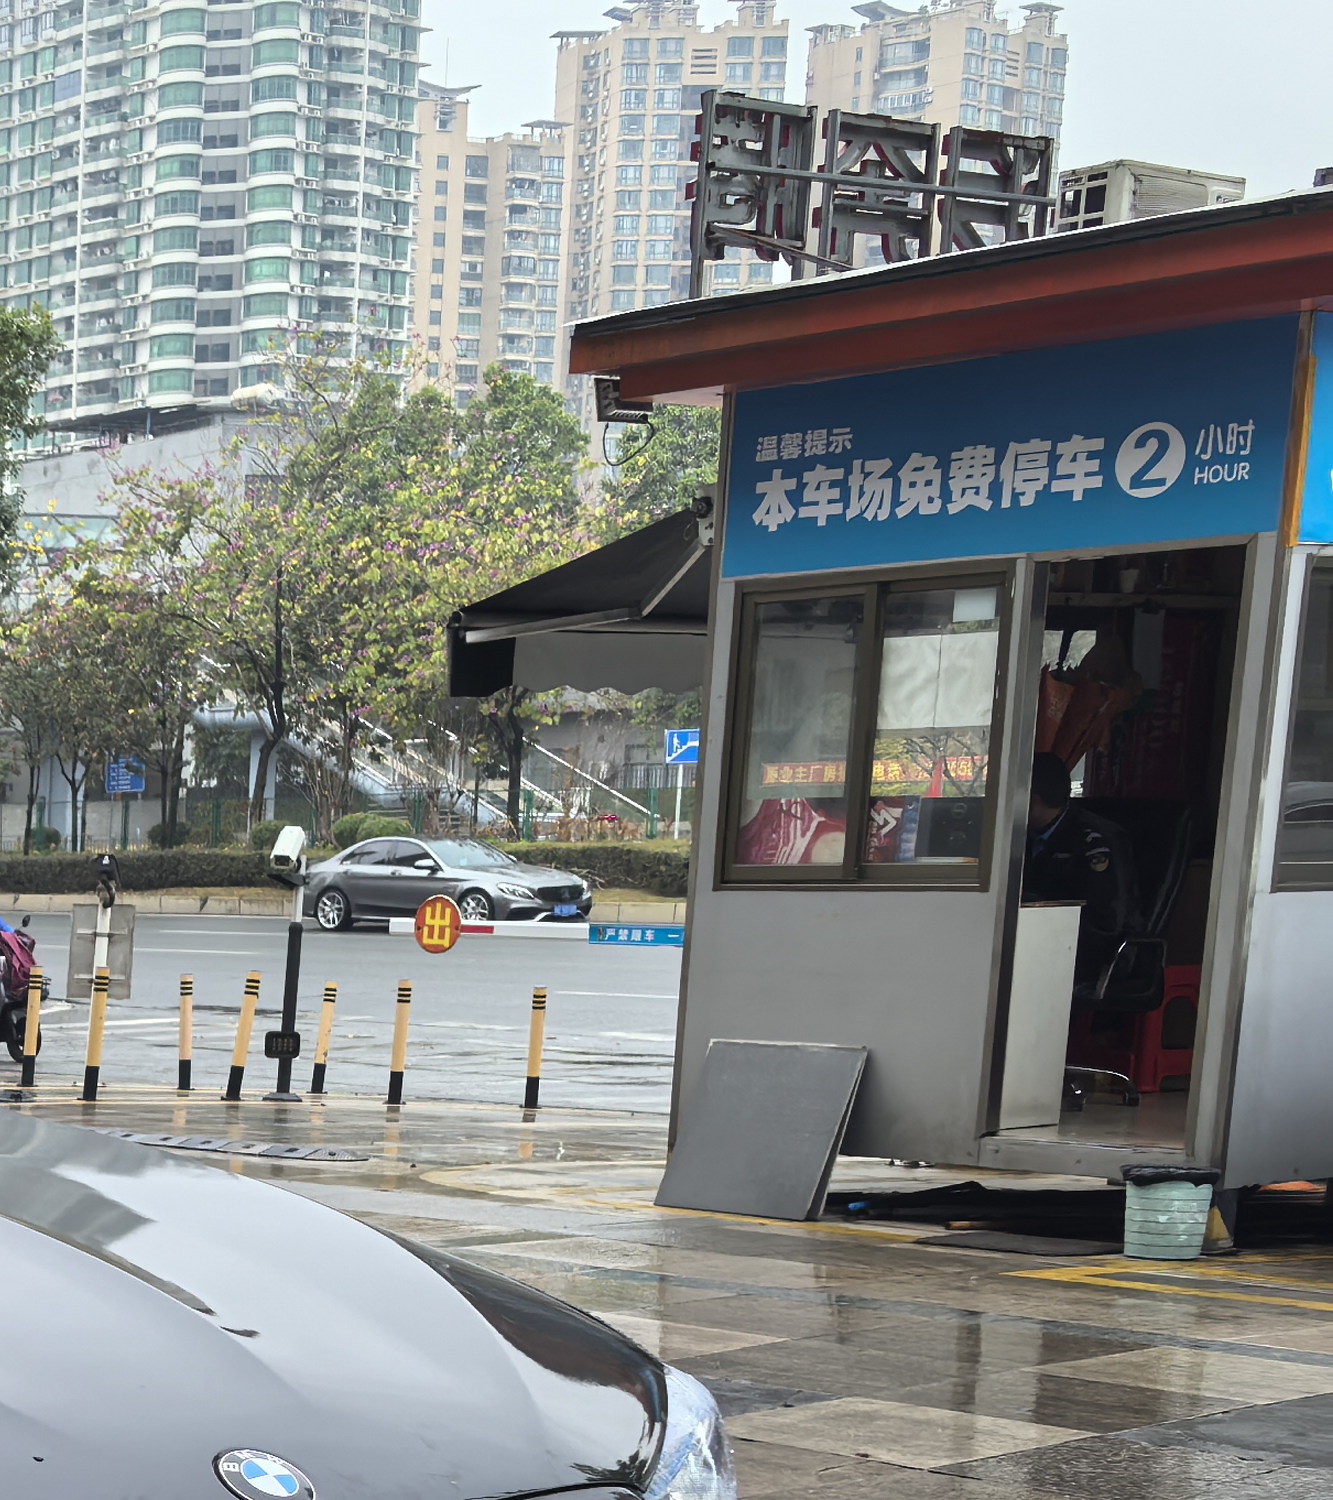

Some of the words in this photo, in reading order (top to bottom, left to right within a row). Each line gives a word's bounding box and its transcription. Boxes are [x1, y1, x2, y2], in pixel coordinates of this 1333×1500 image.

[754, 426, 854, 463] 温馨提示
[1194, 418, 1256, 460] 小时
[751, 433, 1106, 532] 本车场免费停车
[1126, 433, 1176, 495] 2
[1193, 461, 1251, 486] HOUR
[422, 902, 452, 949] 出
